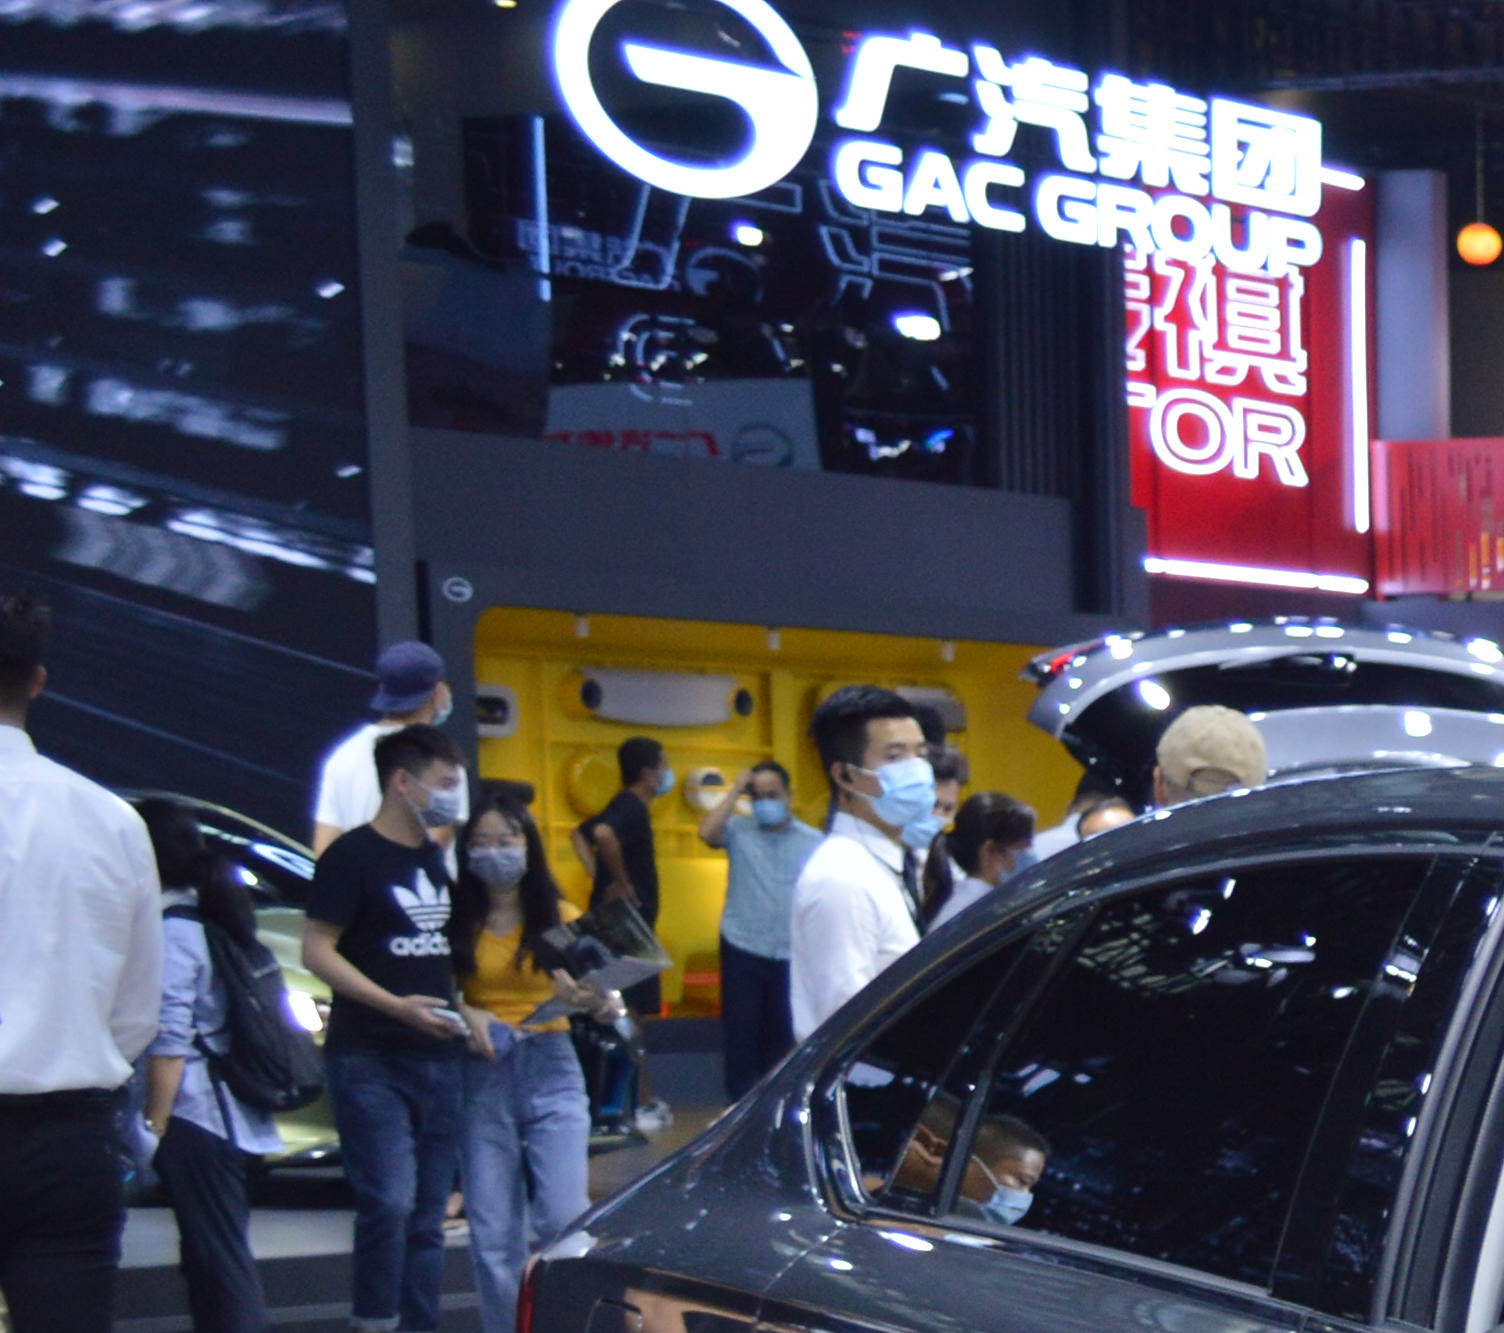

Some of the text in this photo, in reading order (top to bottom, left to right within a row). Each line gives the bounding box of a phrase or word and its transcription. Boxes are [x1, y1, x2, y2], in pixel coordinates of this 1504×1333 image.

[835, 32, 1323, 217] 广汽集团
[835, 140, 1323, 278] GAC GROUP
